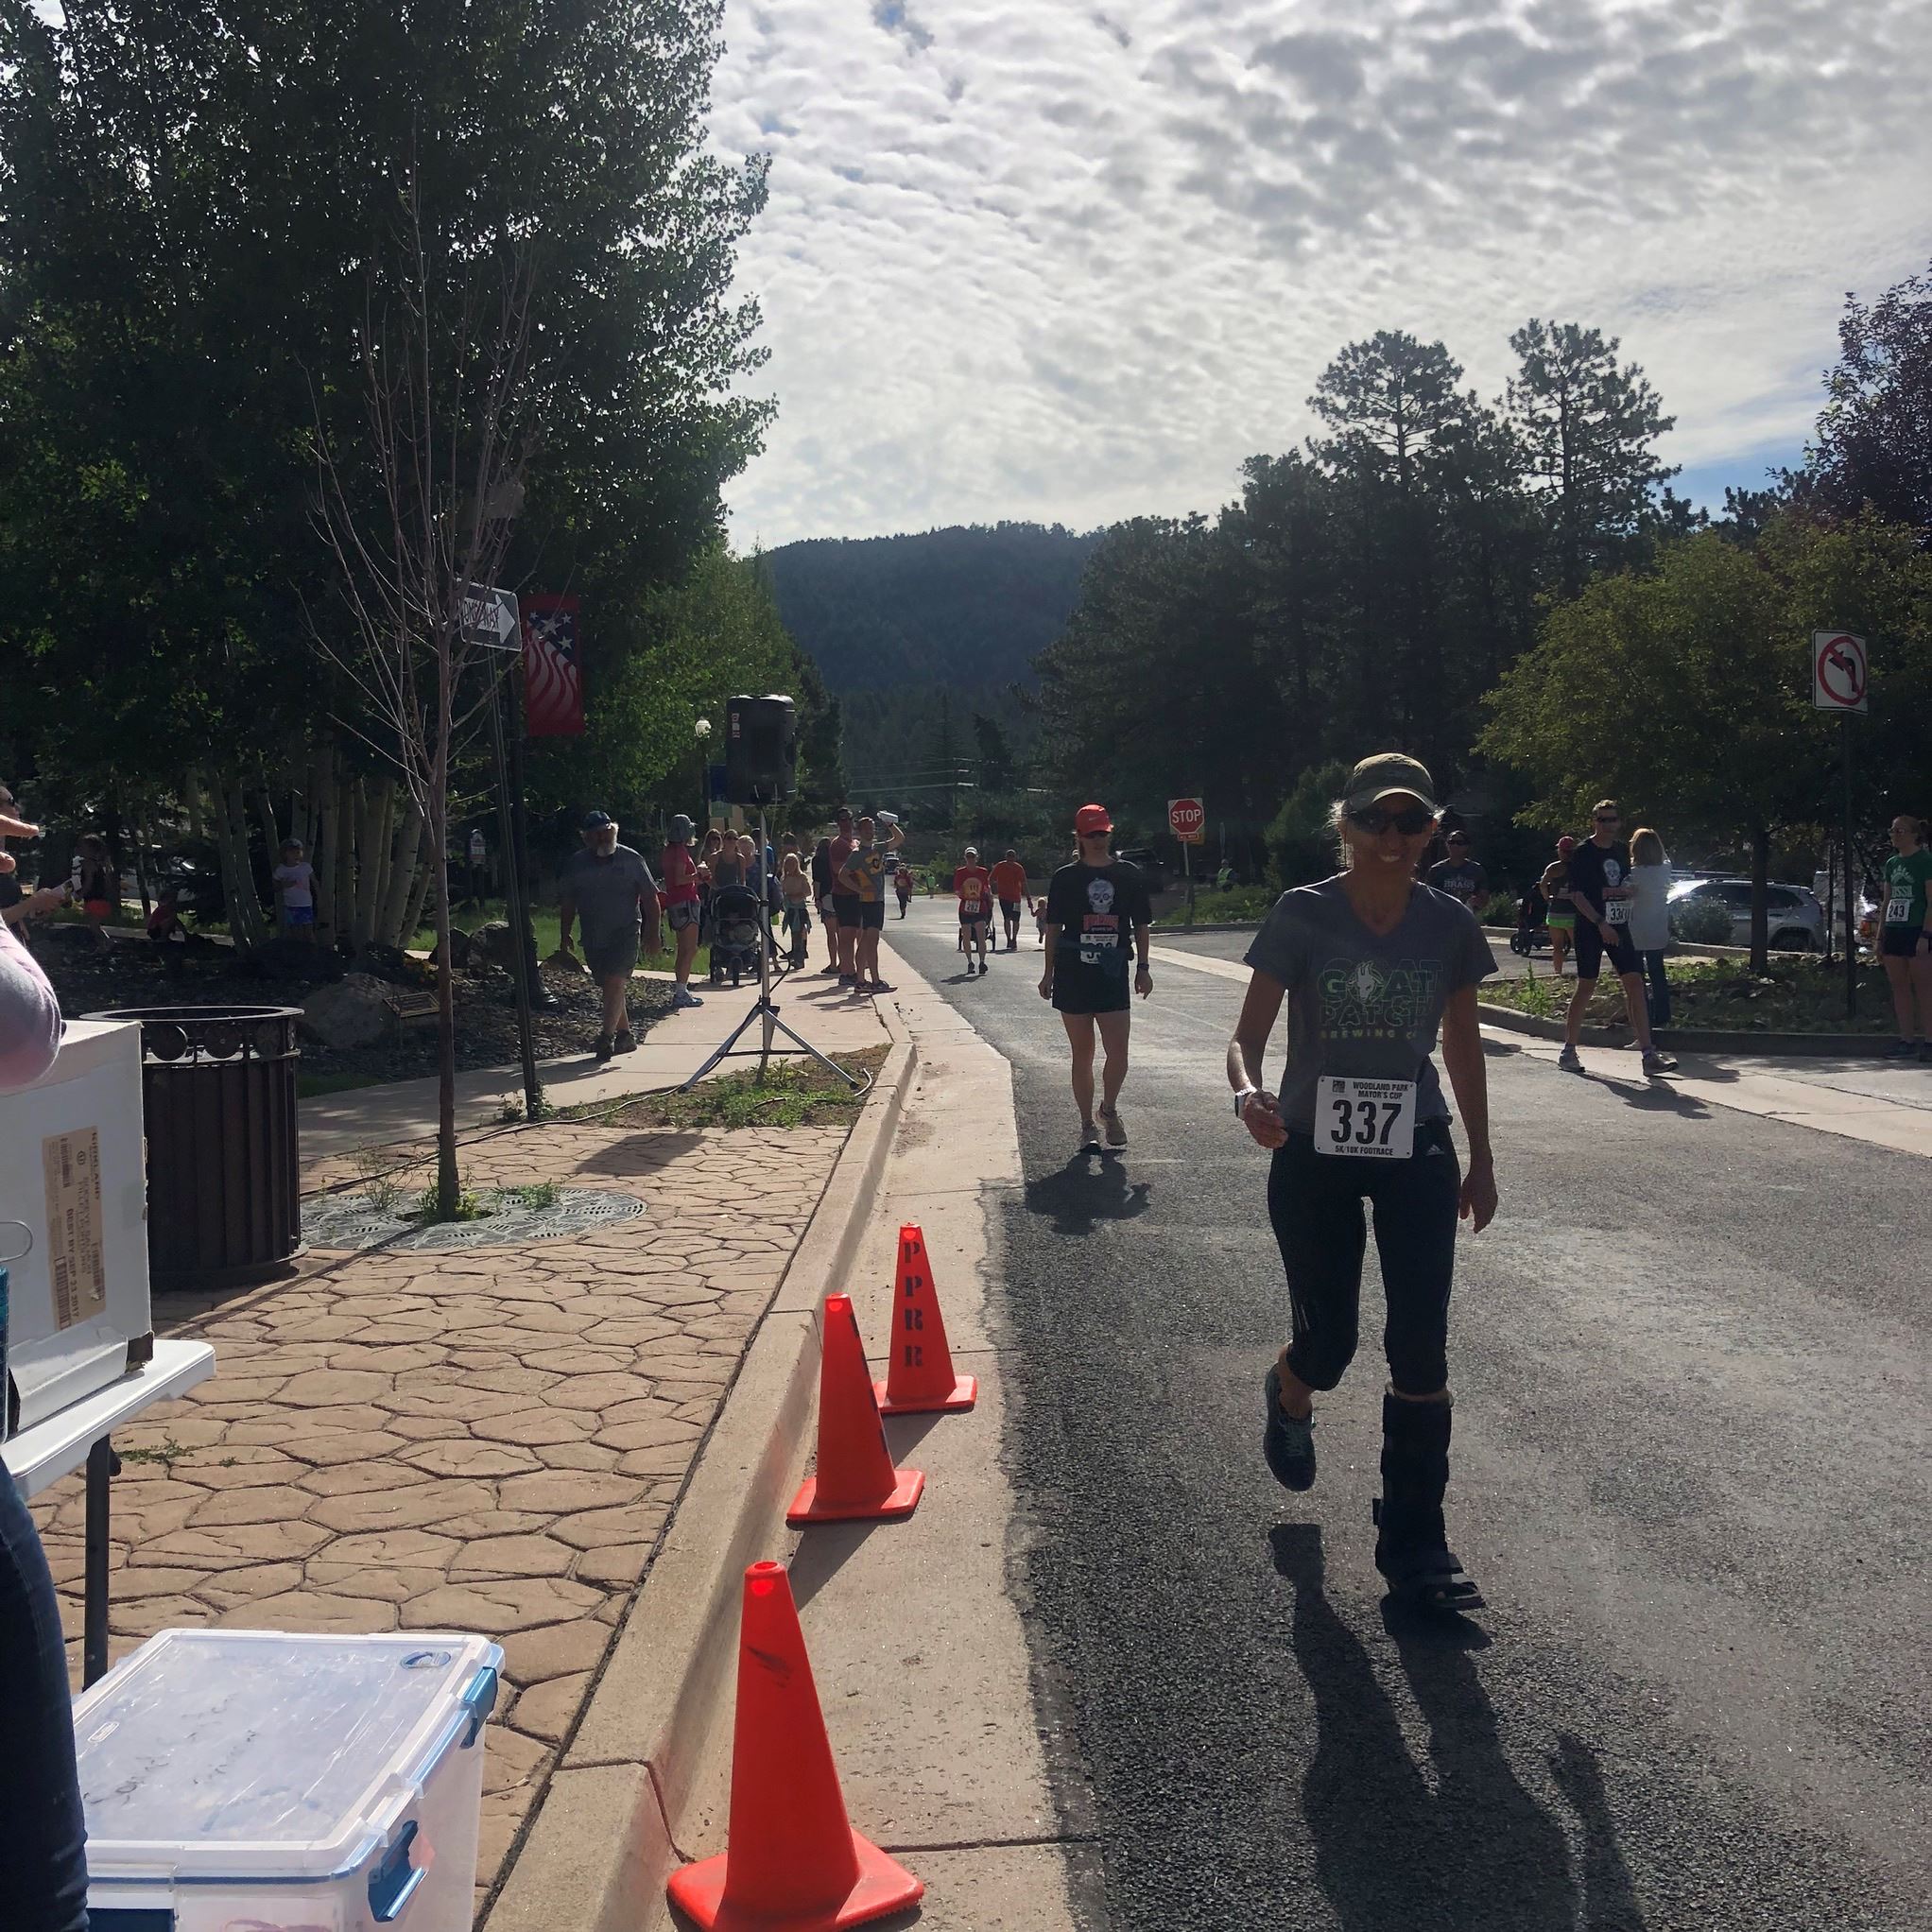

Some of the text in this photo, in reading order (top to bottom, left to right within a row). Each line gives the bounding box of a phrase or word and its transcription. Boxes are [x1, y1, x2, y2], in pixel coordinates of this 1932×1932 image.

[1172, 809, 1201, 823] STOP
[1889, 905, 1905, 918] 243
[1353, 1081, 1408, 1092] WOODLAND PARK
[1358, 1091, 1388, 1099] MAYOR'S
[1331, 1099, 1402, 1145] 337
[1360, 1147, 1393, 1155] FOOTRACE
[904, 1241, 923, 1368] PPRR
